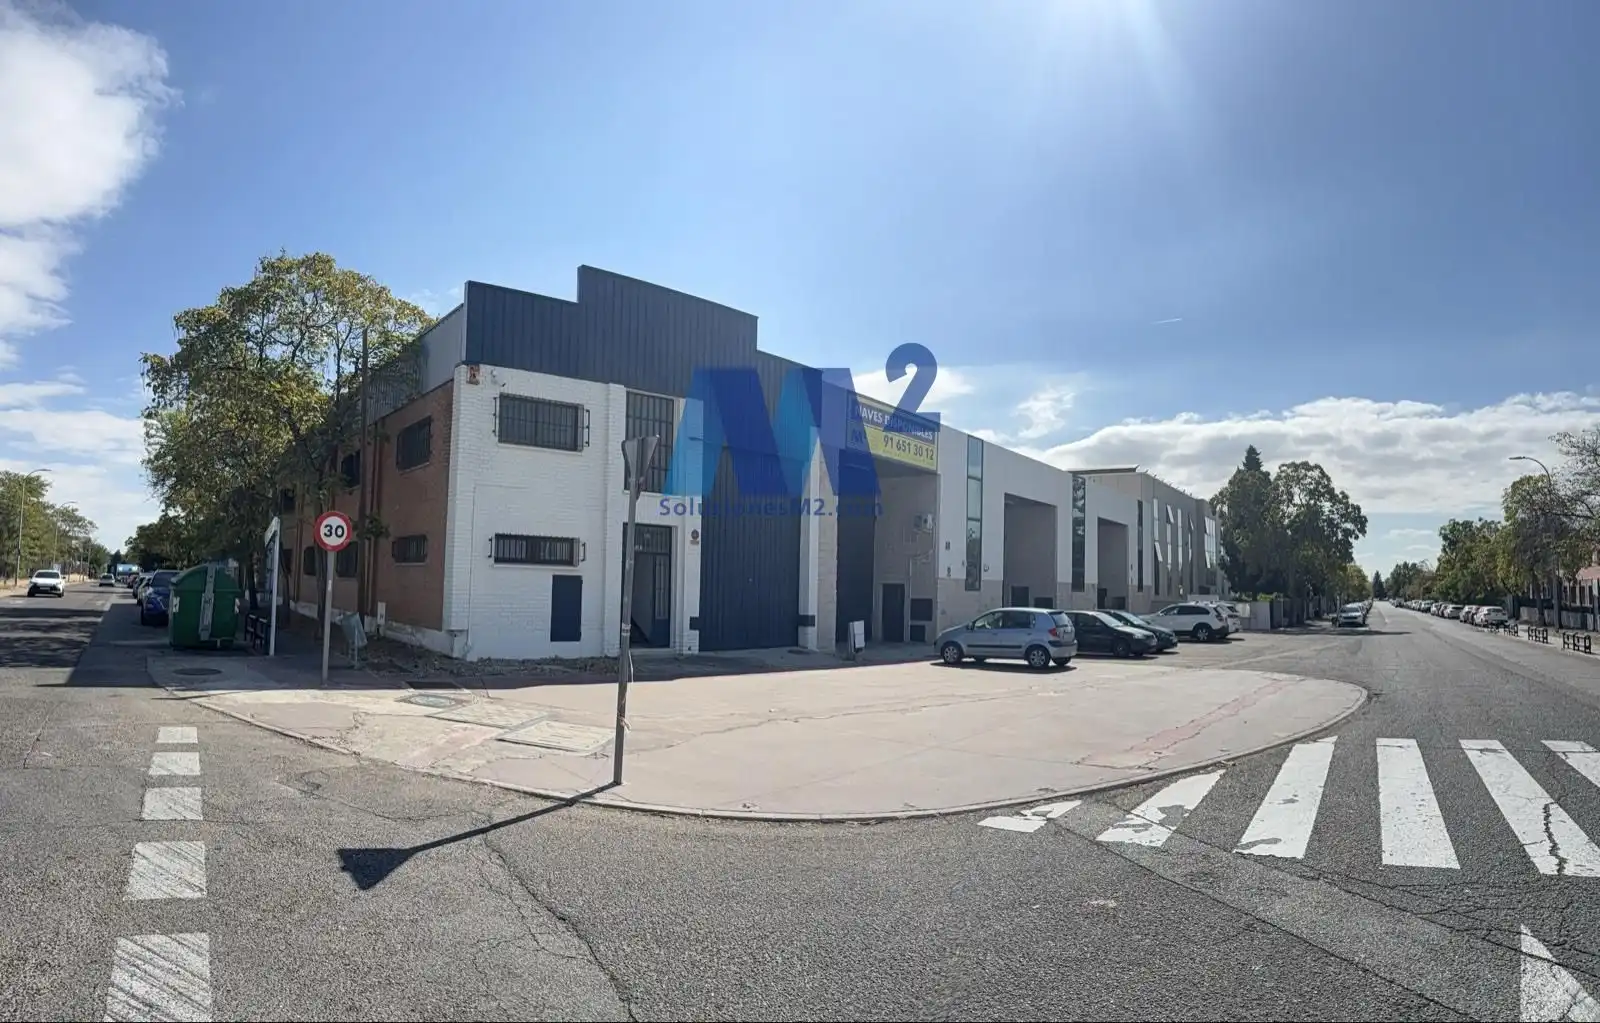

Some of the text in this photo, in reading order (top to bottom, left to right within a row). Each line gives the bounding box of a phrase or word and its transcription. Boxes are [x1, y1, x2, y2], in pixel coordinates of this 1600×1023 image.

[883, 434, 894, 449] 91
[896, 439, 911, 455] 651
[913, 444, 923, 457] 30
[925, 447, 935, 461] 12
[323, 523, 345, 538] 30
